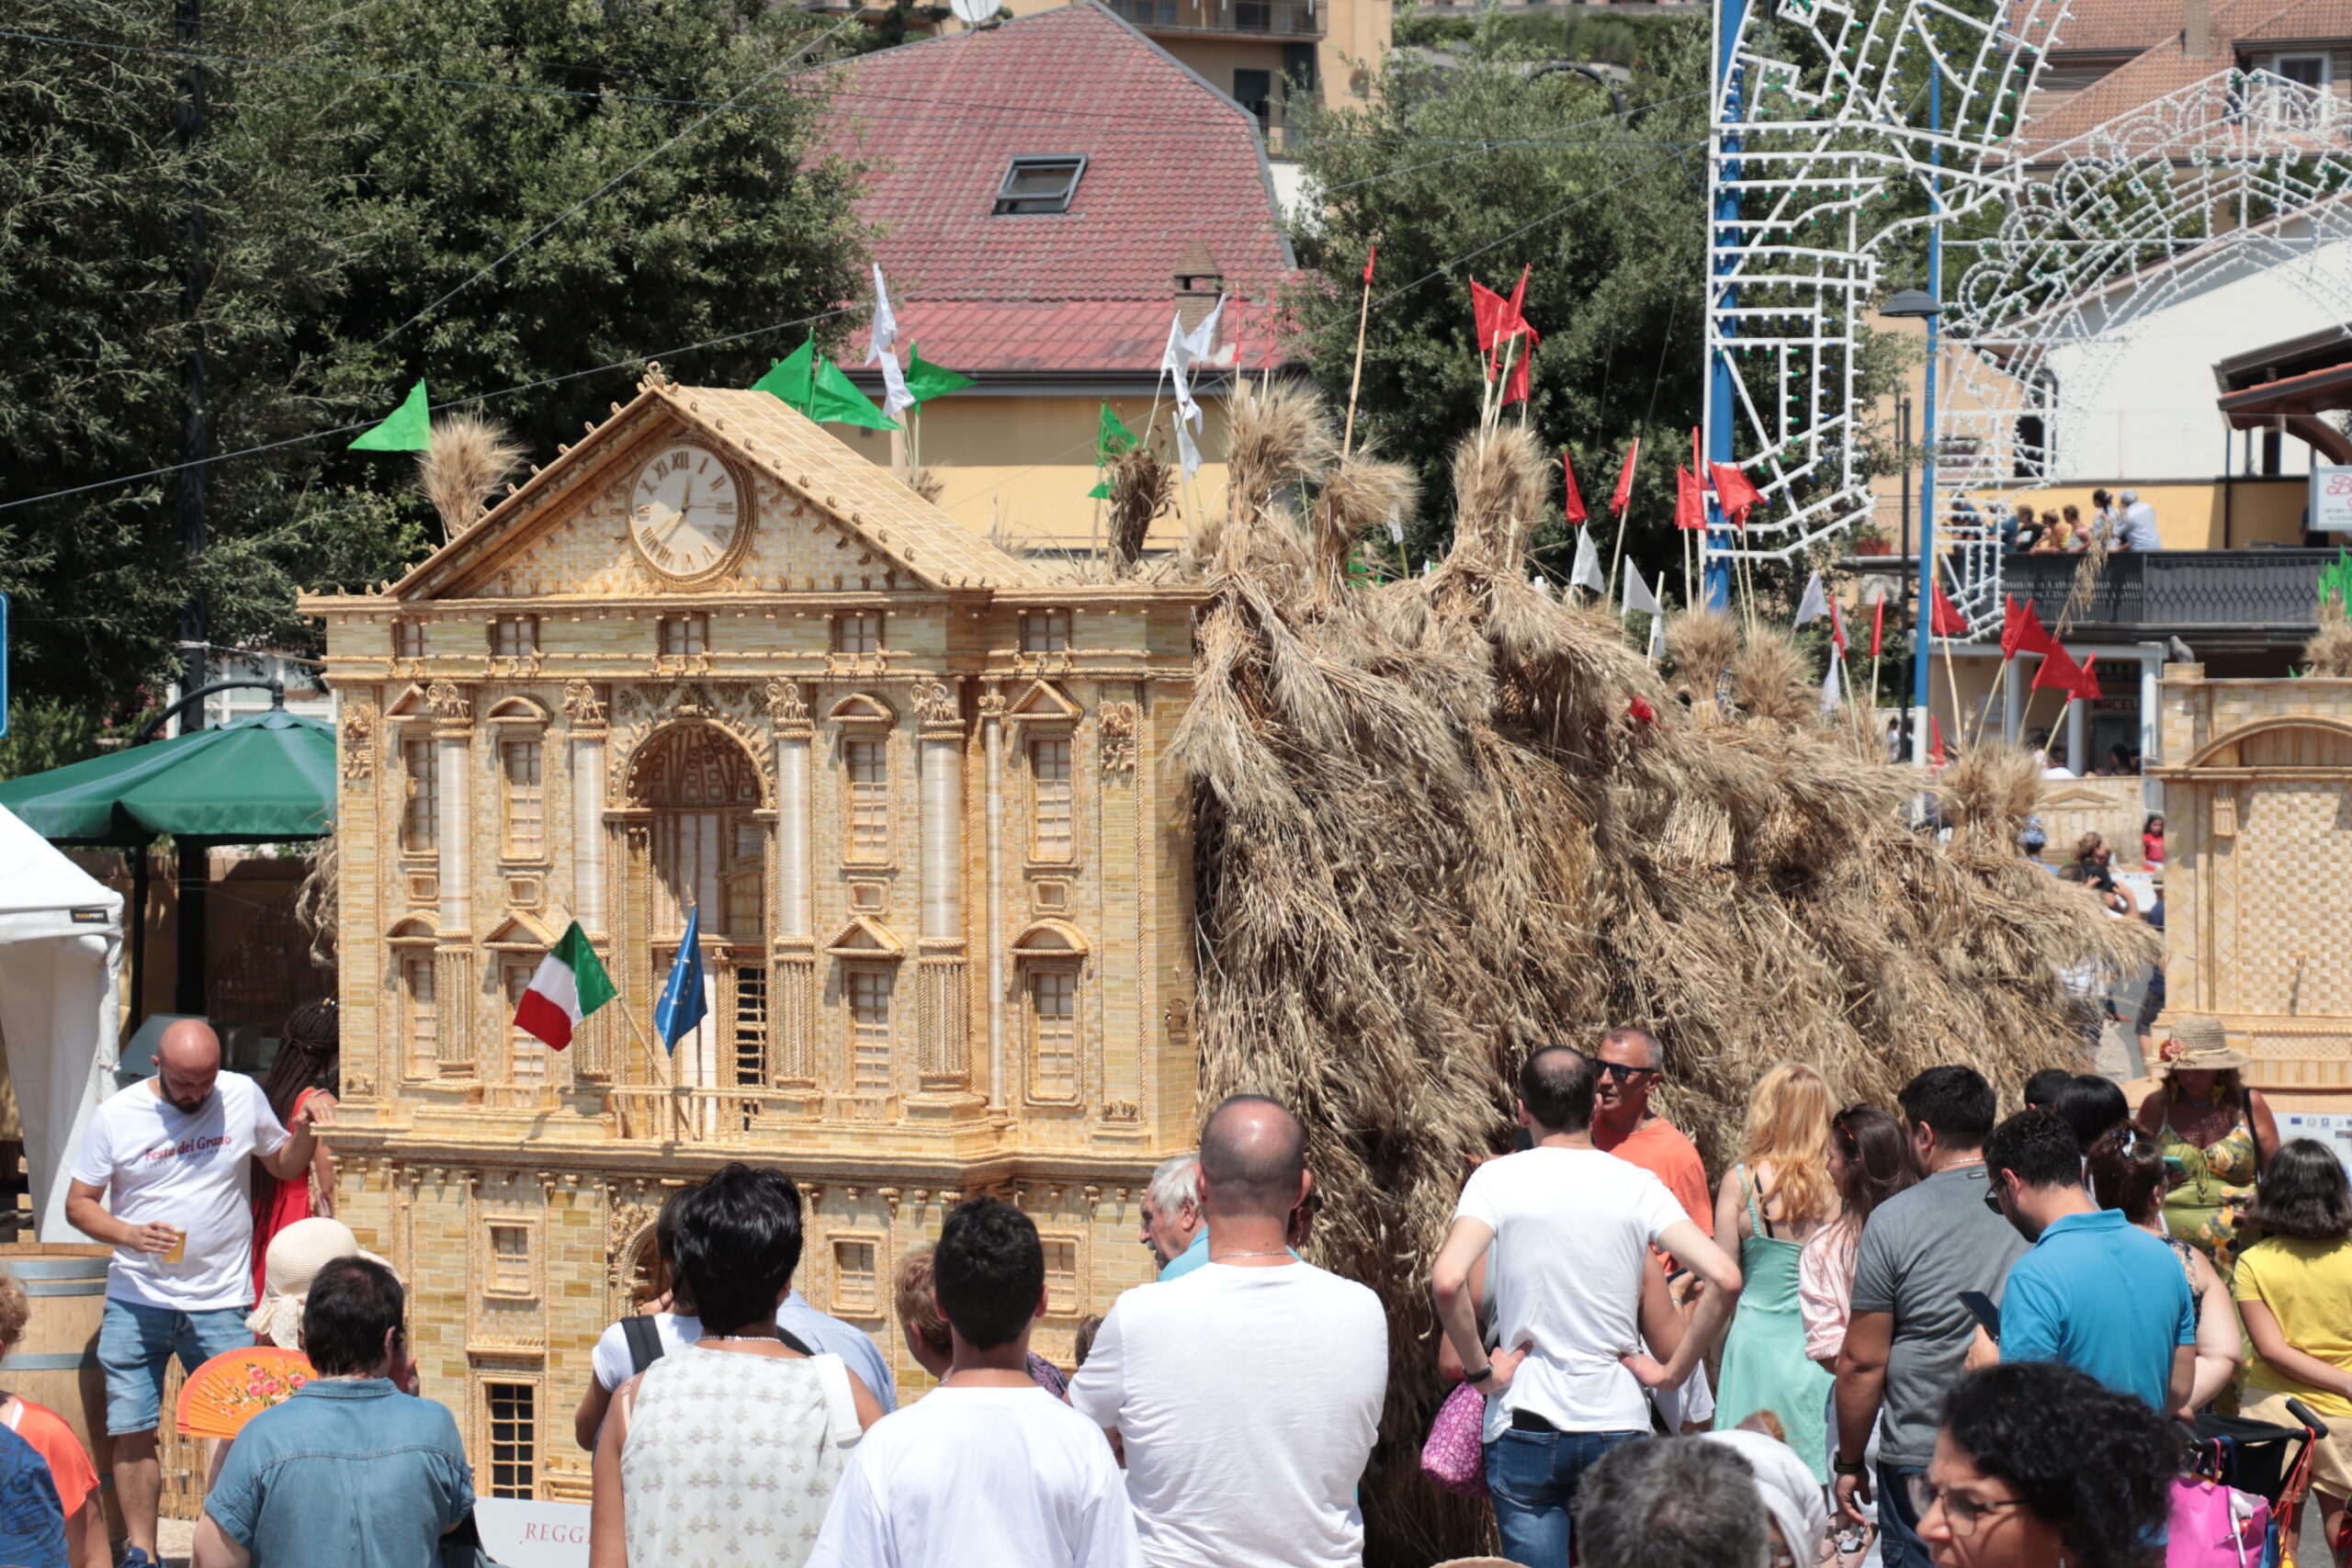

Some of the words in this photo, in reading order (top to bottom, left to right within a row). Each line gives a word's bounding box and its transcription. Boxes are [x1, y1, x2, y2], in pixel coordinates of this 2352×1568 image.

[672, 451, 689, 470] XII
[145, 1146, 175, 1161] Festa
[177, 1138, 194, 1155] del
[197, 1135, 232, 1150] Grano
